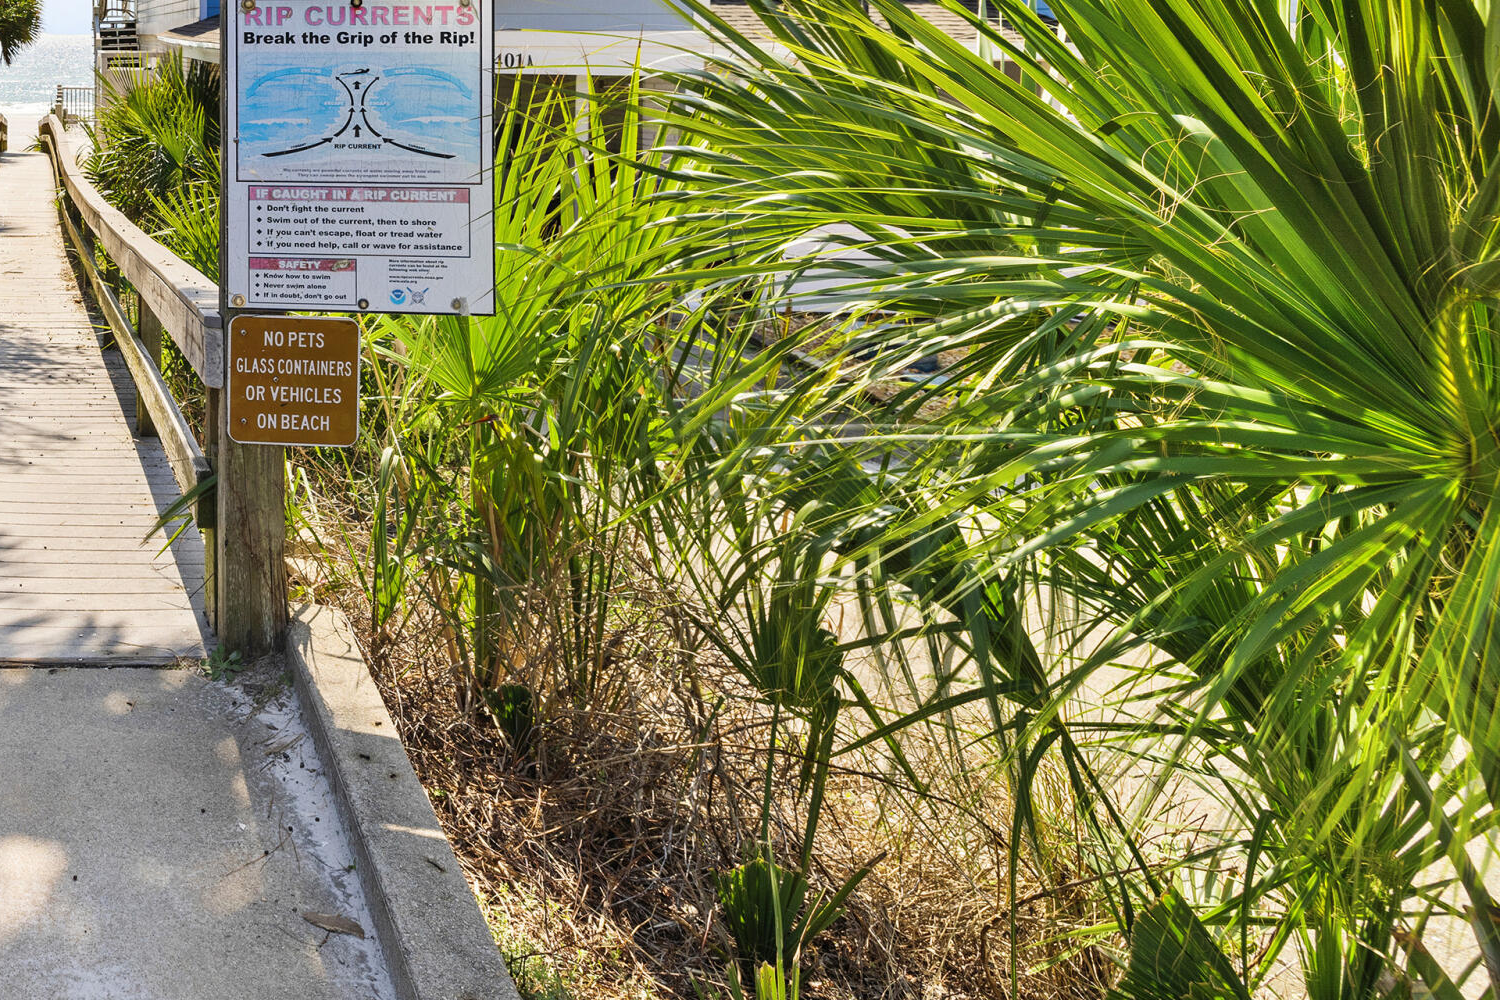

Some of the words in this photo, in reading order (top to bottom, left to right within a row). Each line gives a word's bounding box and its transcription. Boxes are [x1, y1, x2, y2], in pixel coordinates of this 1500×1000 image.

[244, 6, 293, 26] RIP
[304, 6, 475, 26] CURRENTS
[243, 31, 295, 44] Break
[301, 31, 330, 44] the
[336, 31, 373, 47] Grip
[379, 31, 397, 44] of
[403, 31, 433, 44] the
[440, 31, 474, 47] Rip!
[256, 188, 268, 198] IF
[272, 189, 328, 199] CAUGHT
[332, 189, 346, 199] IN
[350, 190, 362, 200] A
[364, 190, 387, 200] RIP
[390, 191, 457, 202] CURRENT
[291, 204, 311, 213] fight
[338, 218, 374, 226] current,
[411, 218, 436, 226] shore
[267, 228, 273, 237] If
[266, 240, 275, 248] If
[318, 241, 339, 249] help,
[278, 260, 321, 269] SAFETY
[279, 291, 303, 299] doubt,
[264, 330, 283, 346] NO
[288, 331, 324, 348] PETS
[236, 357, 274, 373] GLASS
[277, 358, 351, 376] CONTAINERS
[245, 384, 265, 400] OR
[269, 385, 341, 404] VEHICLES
[257, 413, 276, 429] ON
[281, 414, 329, 431] BEACH
